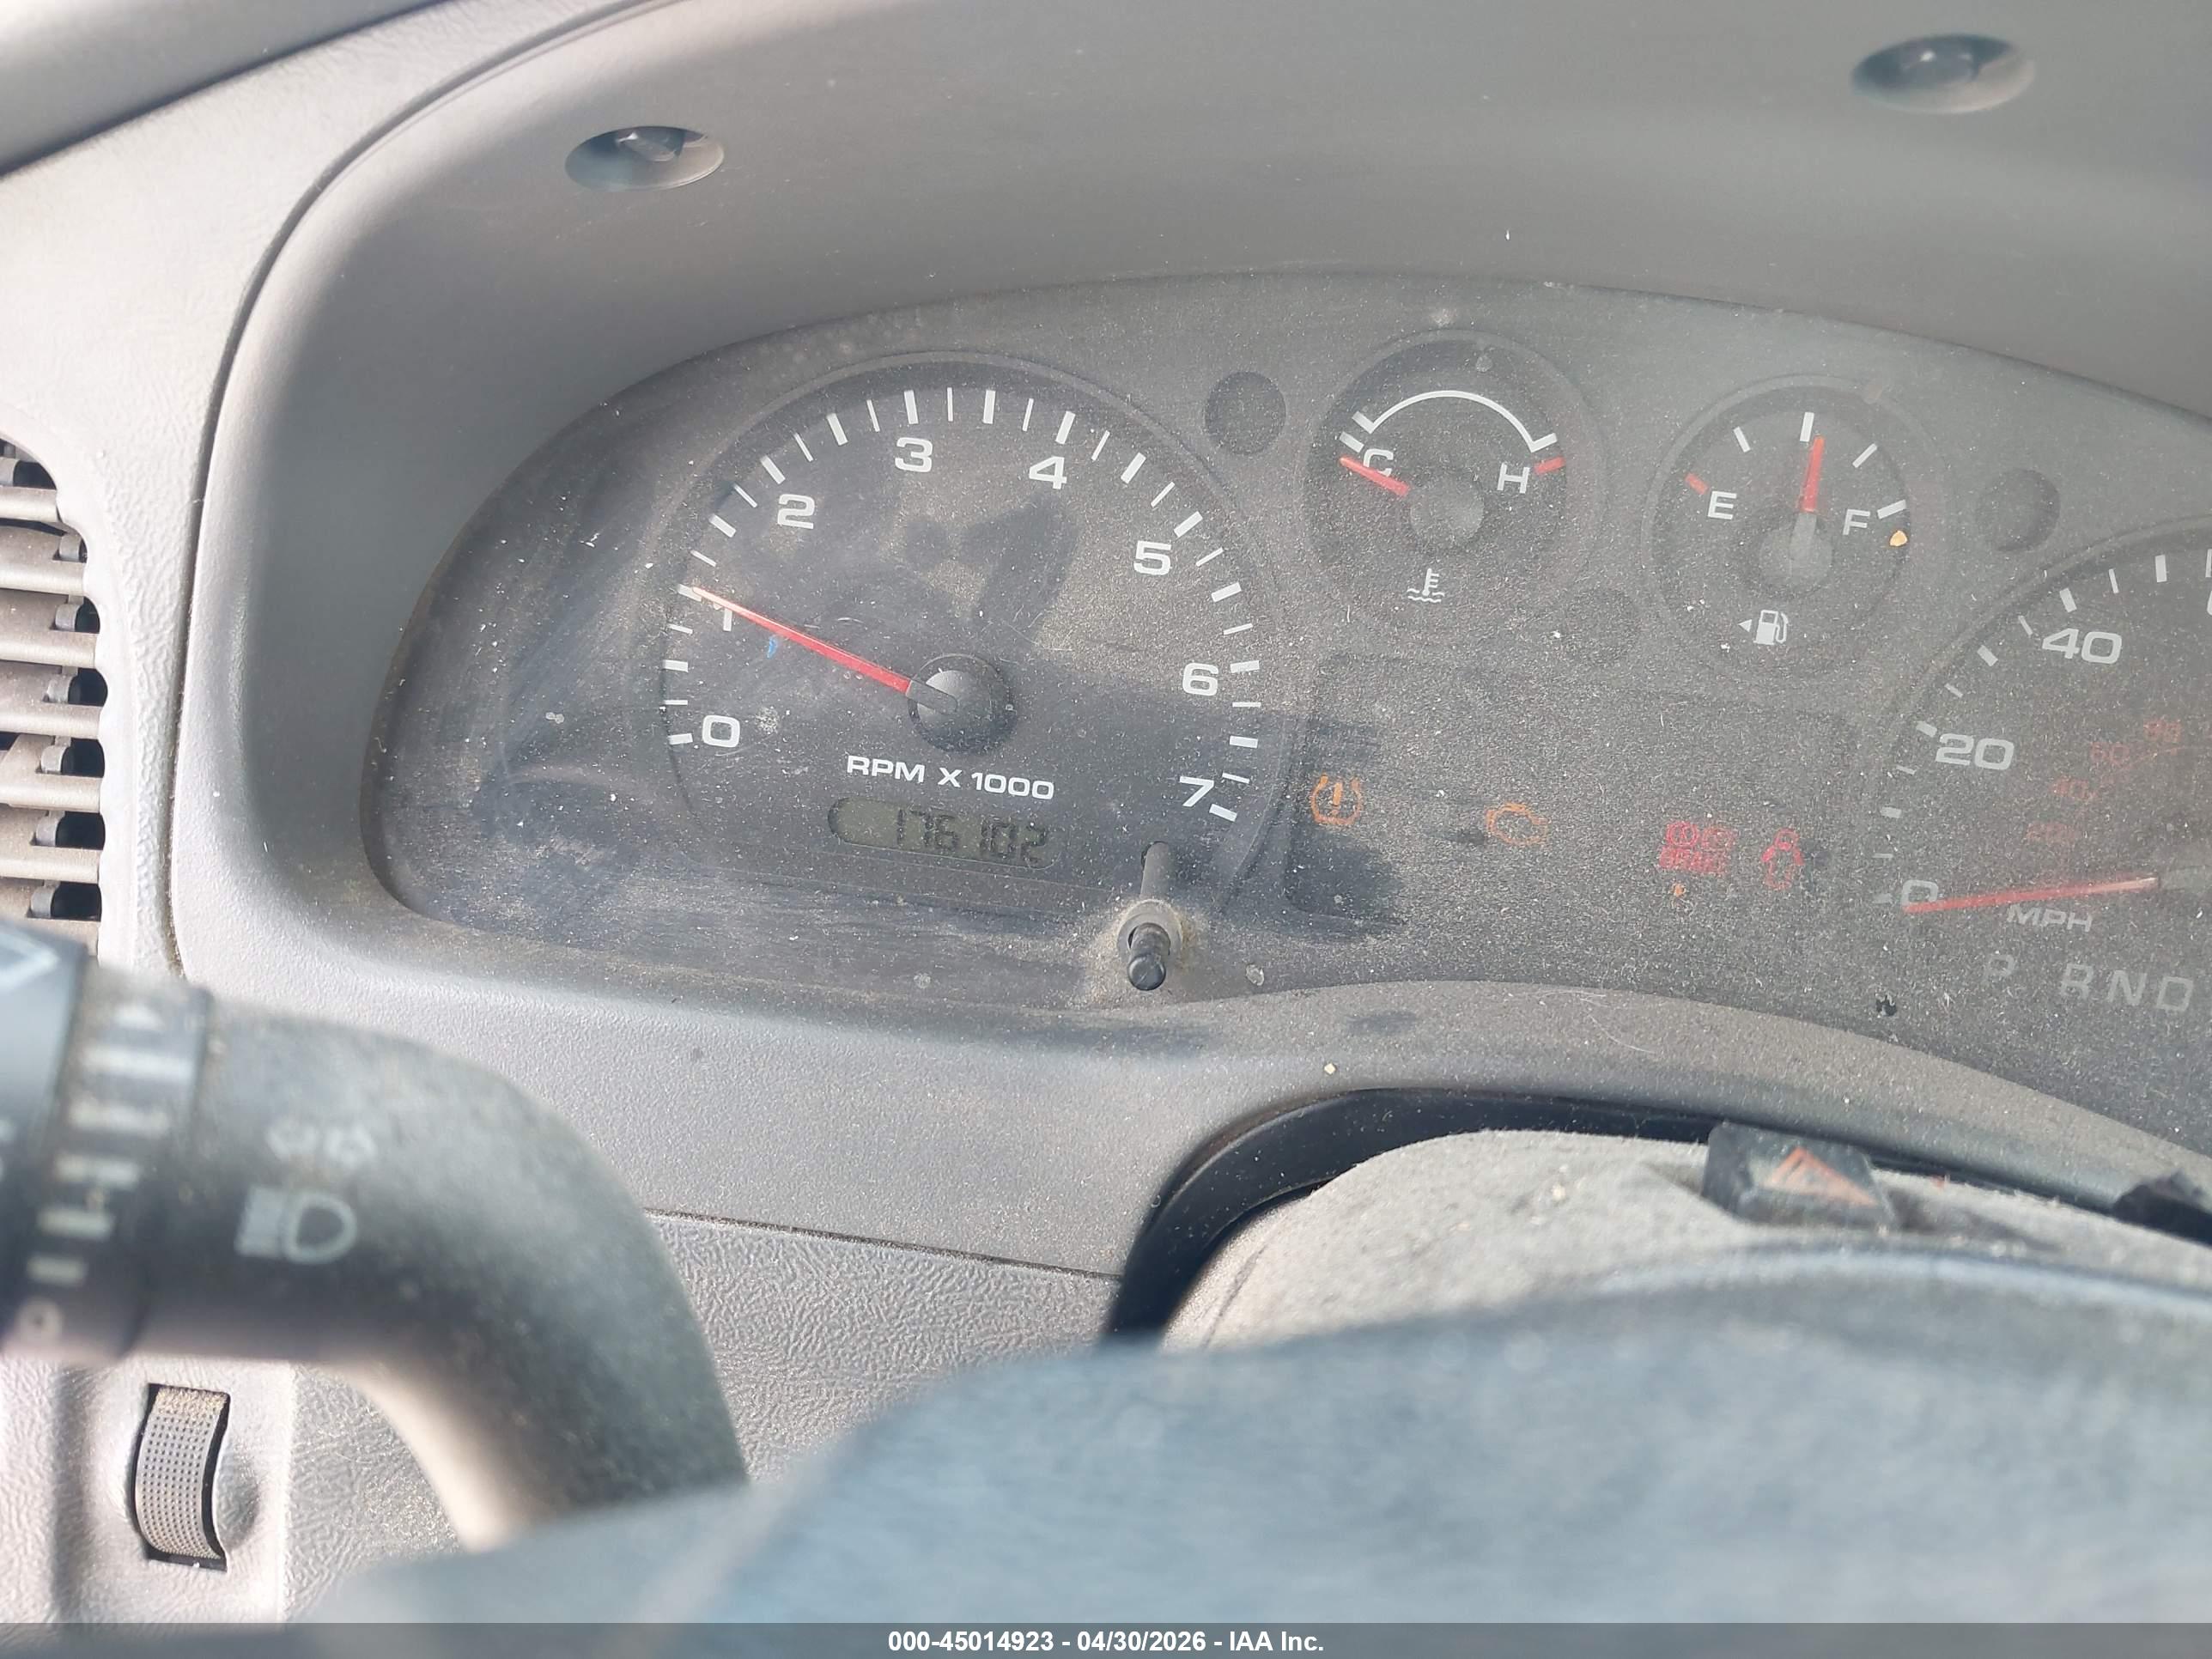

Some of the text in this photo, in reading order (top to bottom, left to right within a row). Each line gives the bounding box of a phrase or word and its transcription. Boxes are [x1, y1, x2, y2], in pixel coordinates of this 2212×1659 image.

[895, 437, 933, 472] 3
[1363, 448, 1394, 477] C
[1029, 456, 1066, 489] 4
[1497, 462, 1531, 494] H
[777, 494, 815, 529] 2
[1708, 490, 1737, 520] E
[1842, 508, 1871, 536] F
[1133, 541, 1171, 575] 5
[2042, 628, 2122, 664] 40
[1183, 663, 1218, 696] 6
[702, 715, 740, 748] 0
[1935, 733, 2015, 770] 20
[847, 755, 1054, 799] RPM X 1000
[1179, 775, 1215, 807] 7
[896, 807, 1048, 864] 176102
[2007, 904, 2094, 933] MPH
[2062, 963, 2094, 999] R
[2106, 969, 2147, 1006] N
[2155, 975, 2194, 1012] D
